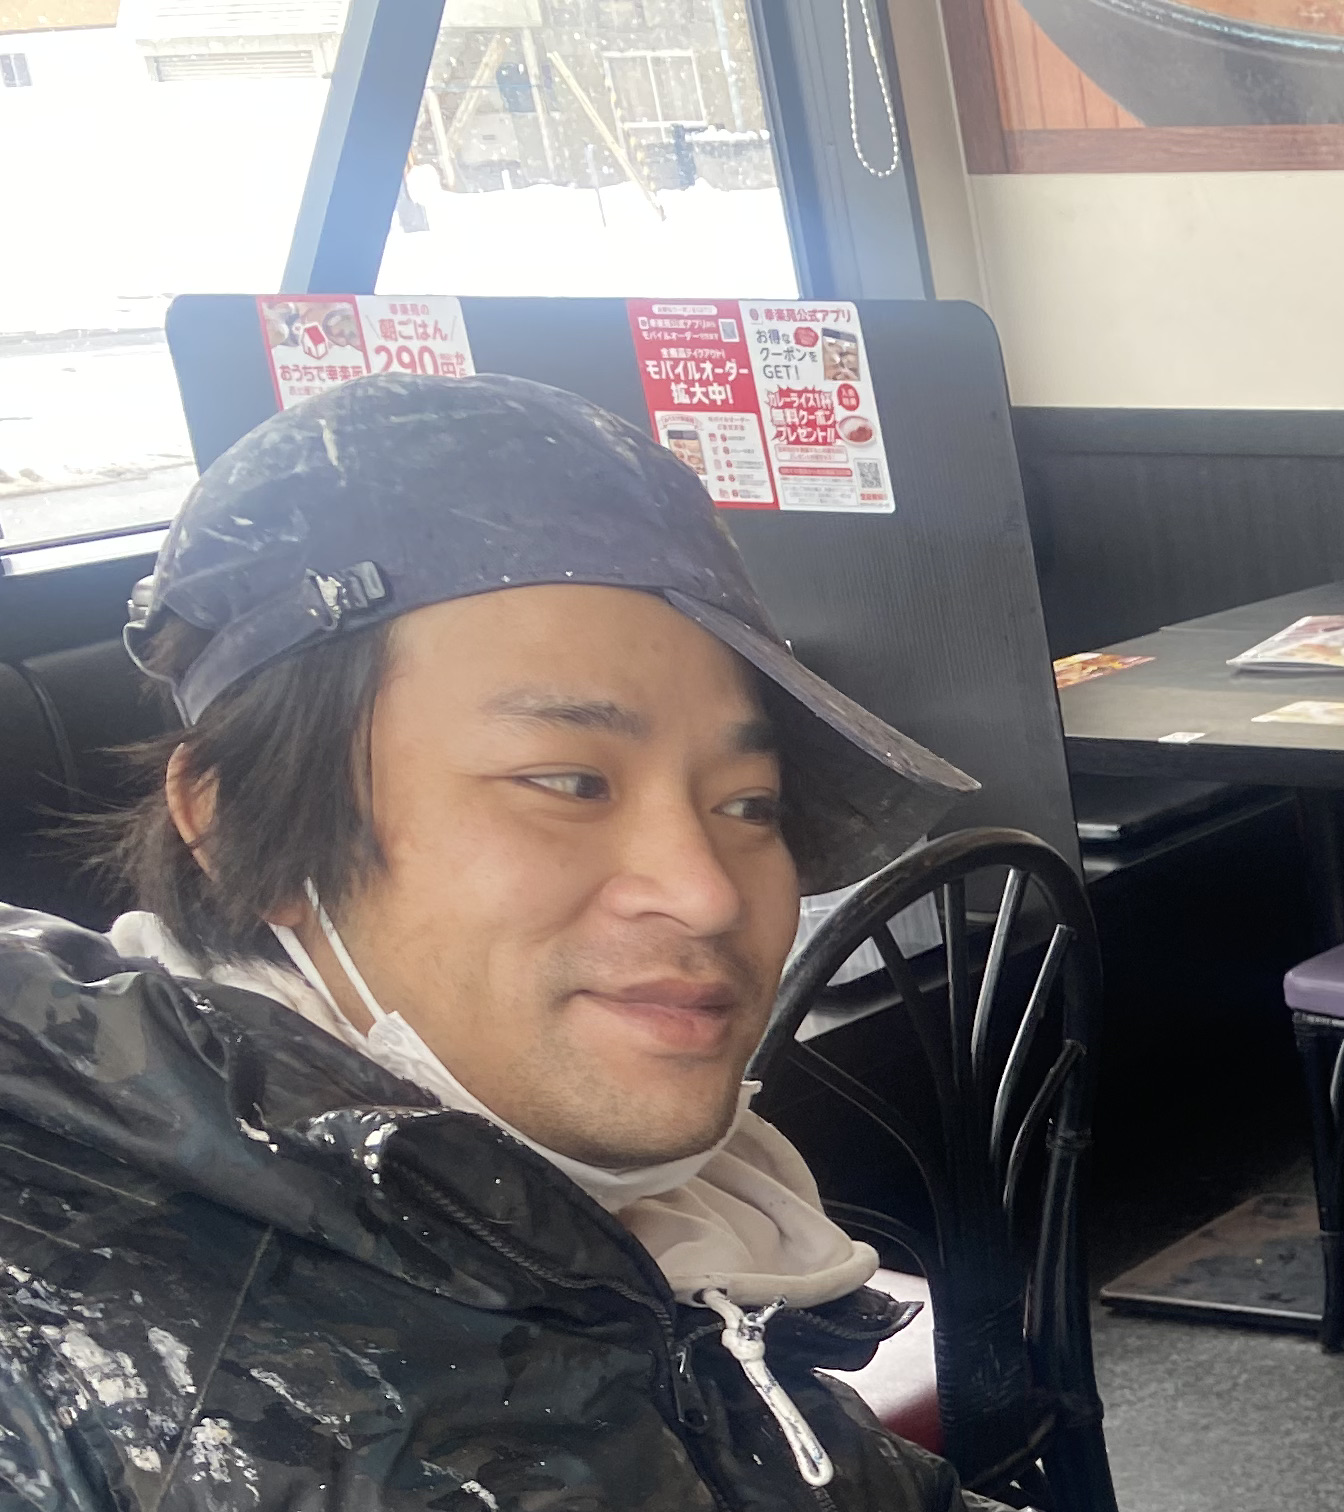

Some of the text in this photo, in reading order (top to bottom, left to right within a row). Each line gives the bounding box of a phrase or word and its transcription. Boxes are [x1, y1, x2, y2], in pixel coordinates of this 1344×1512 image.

[379, 319, 449, 342] 朝ごはん
[760, 346, 818, 363] クーポンを
[645, 359, 749, 381] モバイルオーダー
[762, 364, 800, 380] GET!
